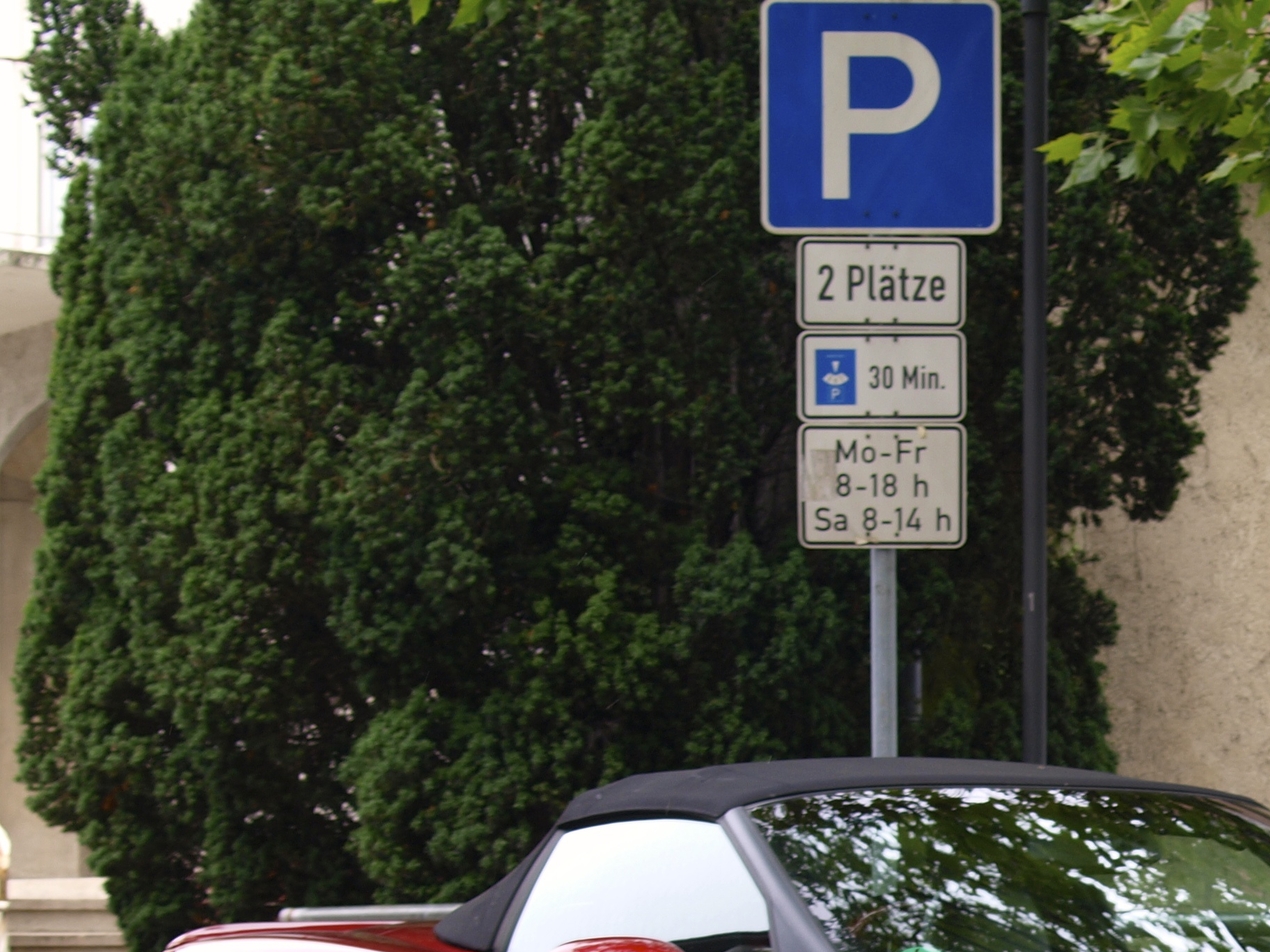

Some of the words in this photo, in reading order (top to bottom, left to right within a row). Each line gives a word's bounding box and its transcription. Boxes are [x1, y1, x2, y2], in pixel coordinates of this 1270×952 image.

[822, 31, 941, 200] P
[818, 265, 834, 301] 2
[848, 264, 946, 301] Plätze
[869, 365, 893, 389] 30
[902, 364, 946, 390] Min.
[835, 439, 927, 464] Mo-Fr
[836, 473, 897, 497] 8-18
[913, 473, 928, 497] h
[814, 507, 848, 531] Sa
[862, 507, 921, 531] 8-14
[936, 507, 951, 531] h
